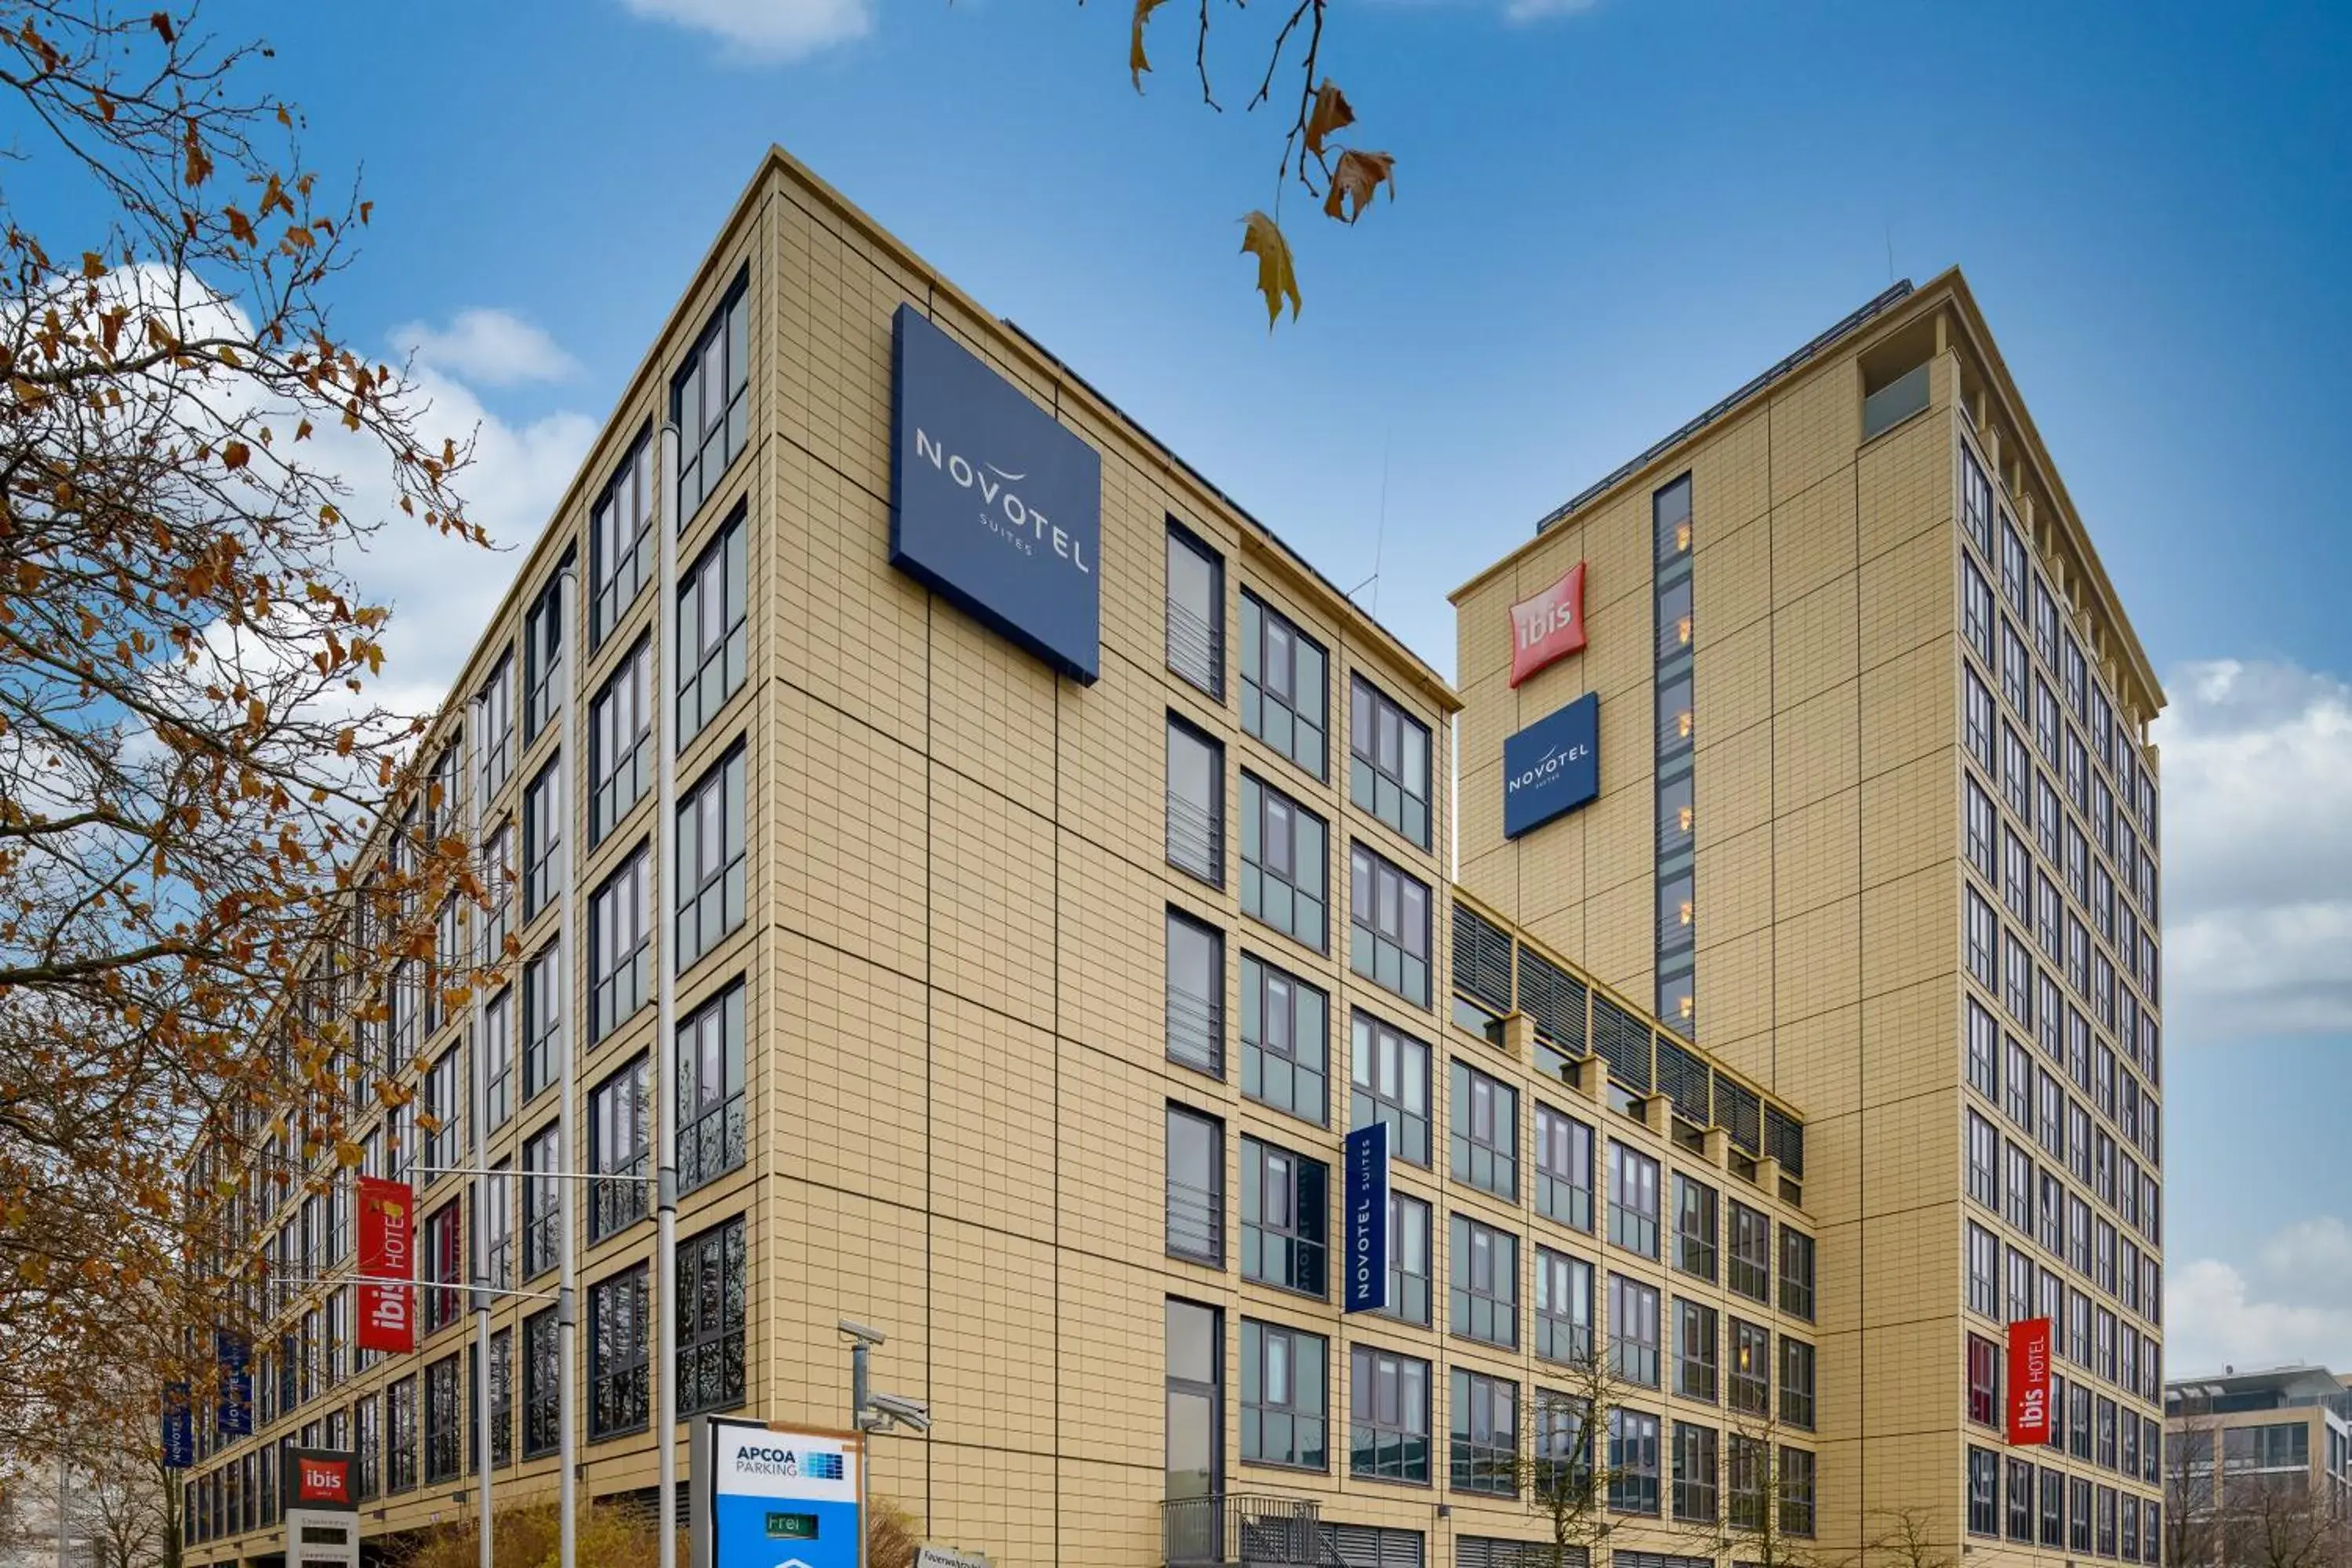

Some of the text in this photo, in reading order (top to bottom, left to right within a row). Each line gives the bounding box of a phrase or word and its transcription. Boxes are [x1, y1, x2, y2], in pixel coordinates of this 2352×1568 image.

[916, 427, 1089, 572] NOVOTEL
[979, 513, 1033, 556] SUITES
[1520, 601, 1571, 651] ibis
[1509, 744, 1589, 793] NOVOTEL
[1357, 1139, 1370, 1298] NOVOTEL SUITES
[372, 1278, 405, 1330] ibis
[228, 1370, 240, 1428] NOVTEL
[2019, 1335, 2044, 1429] ibis HOTEL
[306, 1469, 341, 1489] ibis
[736, 1461, 797, 1476] PARKING
[737, 1446, 796, 1464] APCOA
